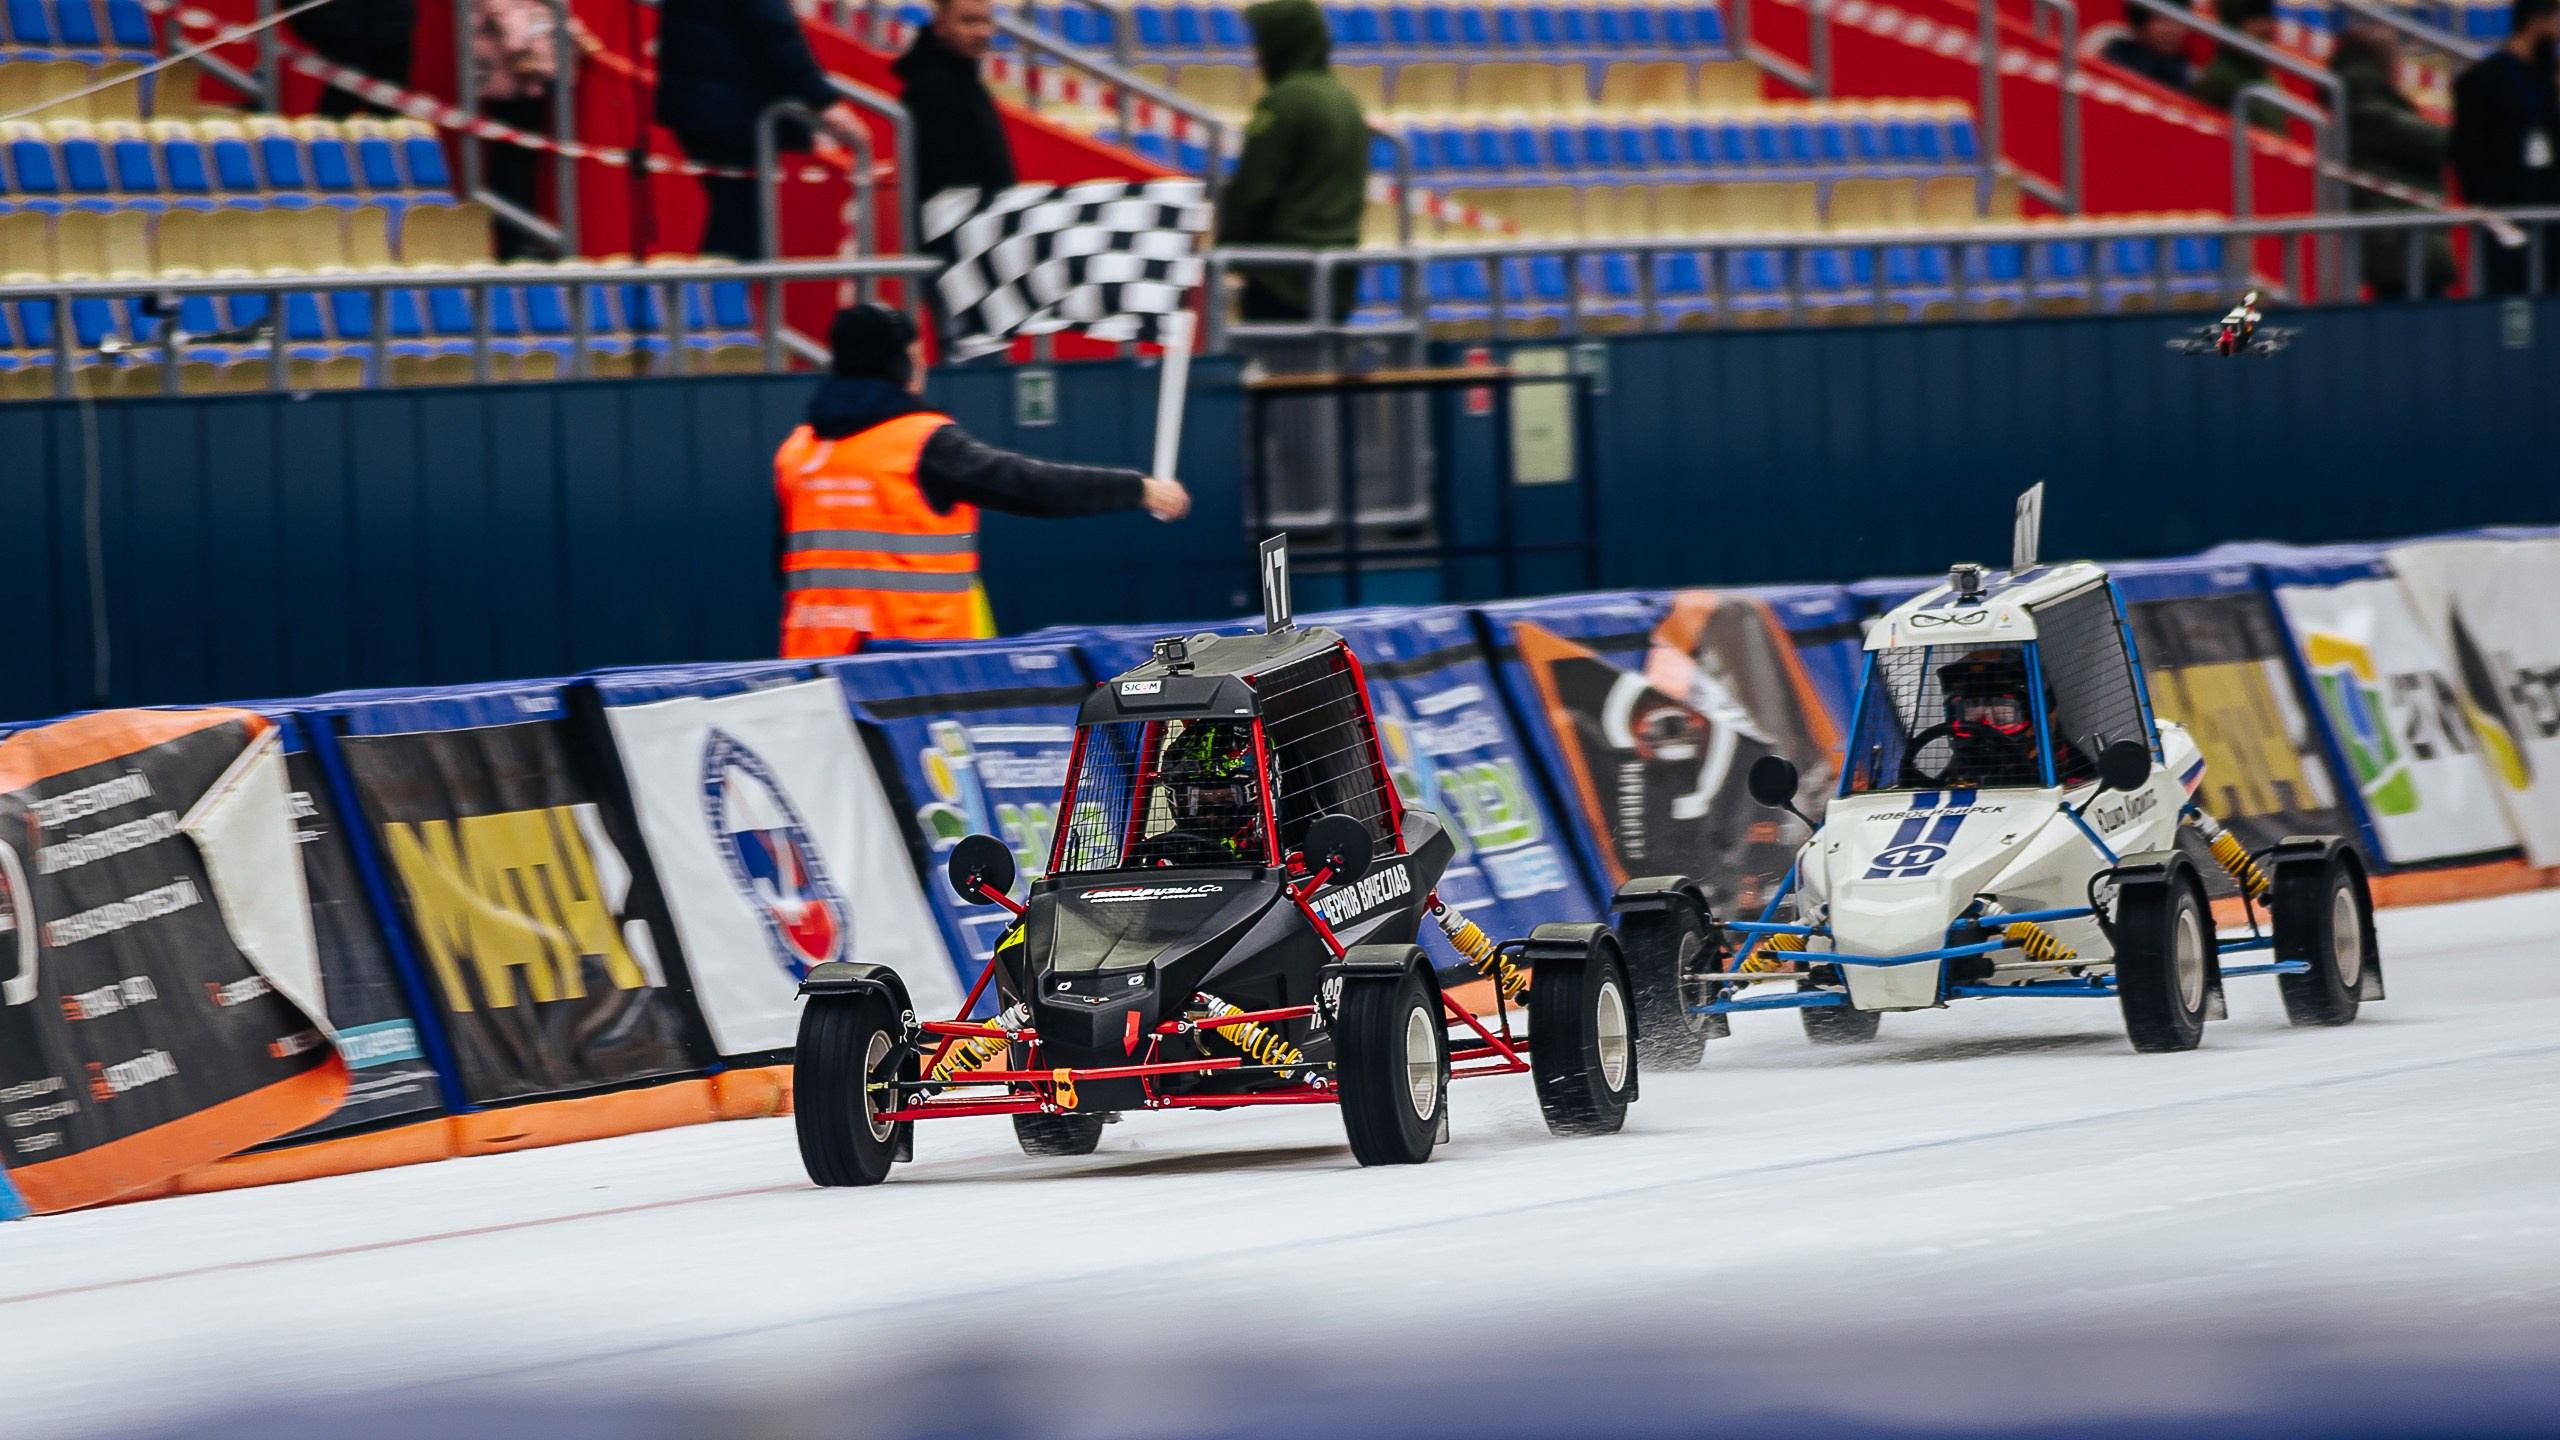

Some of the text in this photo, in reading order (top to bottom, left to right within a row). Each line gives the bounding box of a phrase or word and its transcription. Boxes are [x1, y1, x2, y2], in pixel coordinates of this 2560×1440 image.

[1265, 547, 1288, 624] 17
[1124, 681, 1158, 692] SJCAM
[1866, 806, 2006, 822] НОВОСИБИРСК
[1884, 848, 1933, 865] 11
[1320, 863, 1412, 926] ЧЕРНОВ ВЯЧЕСЛАВ
